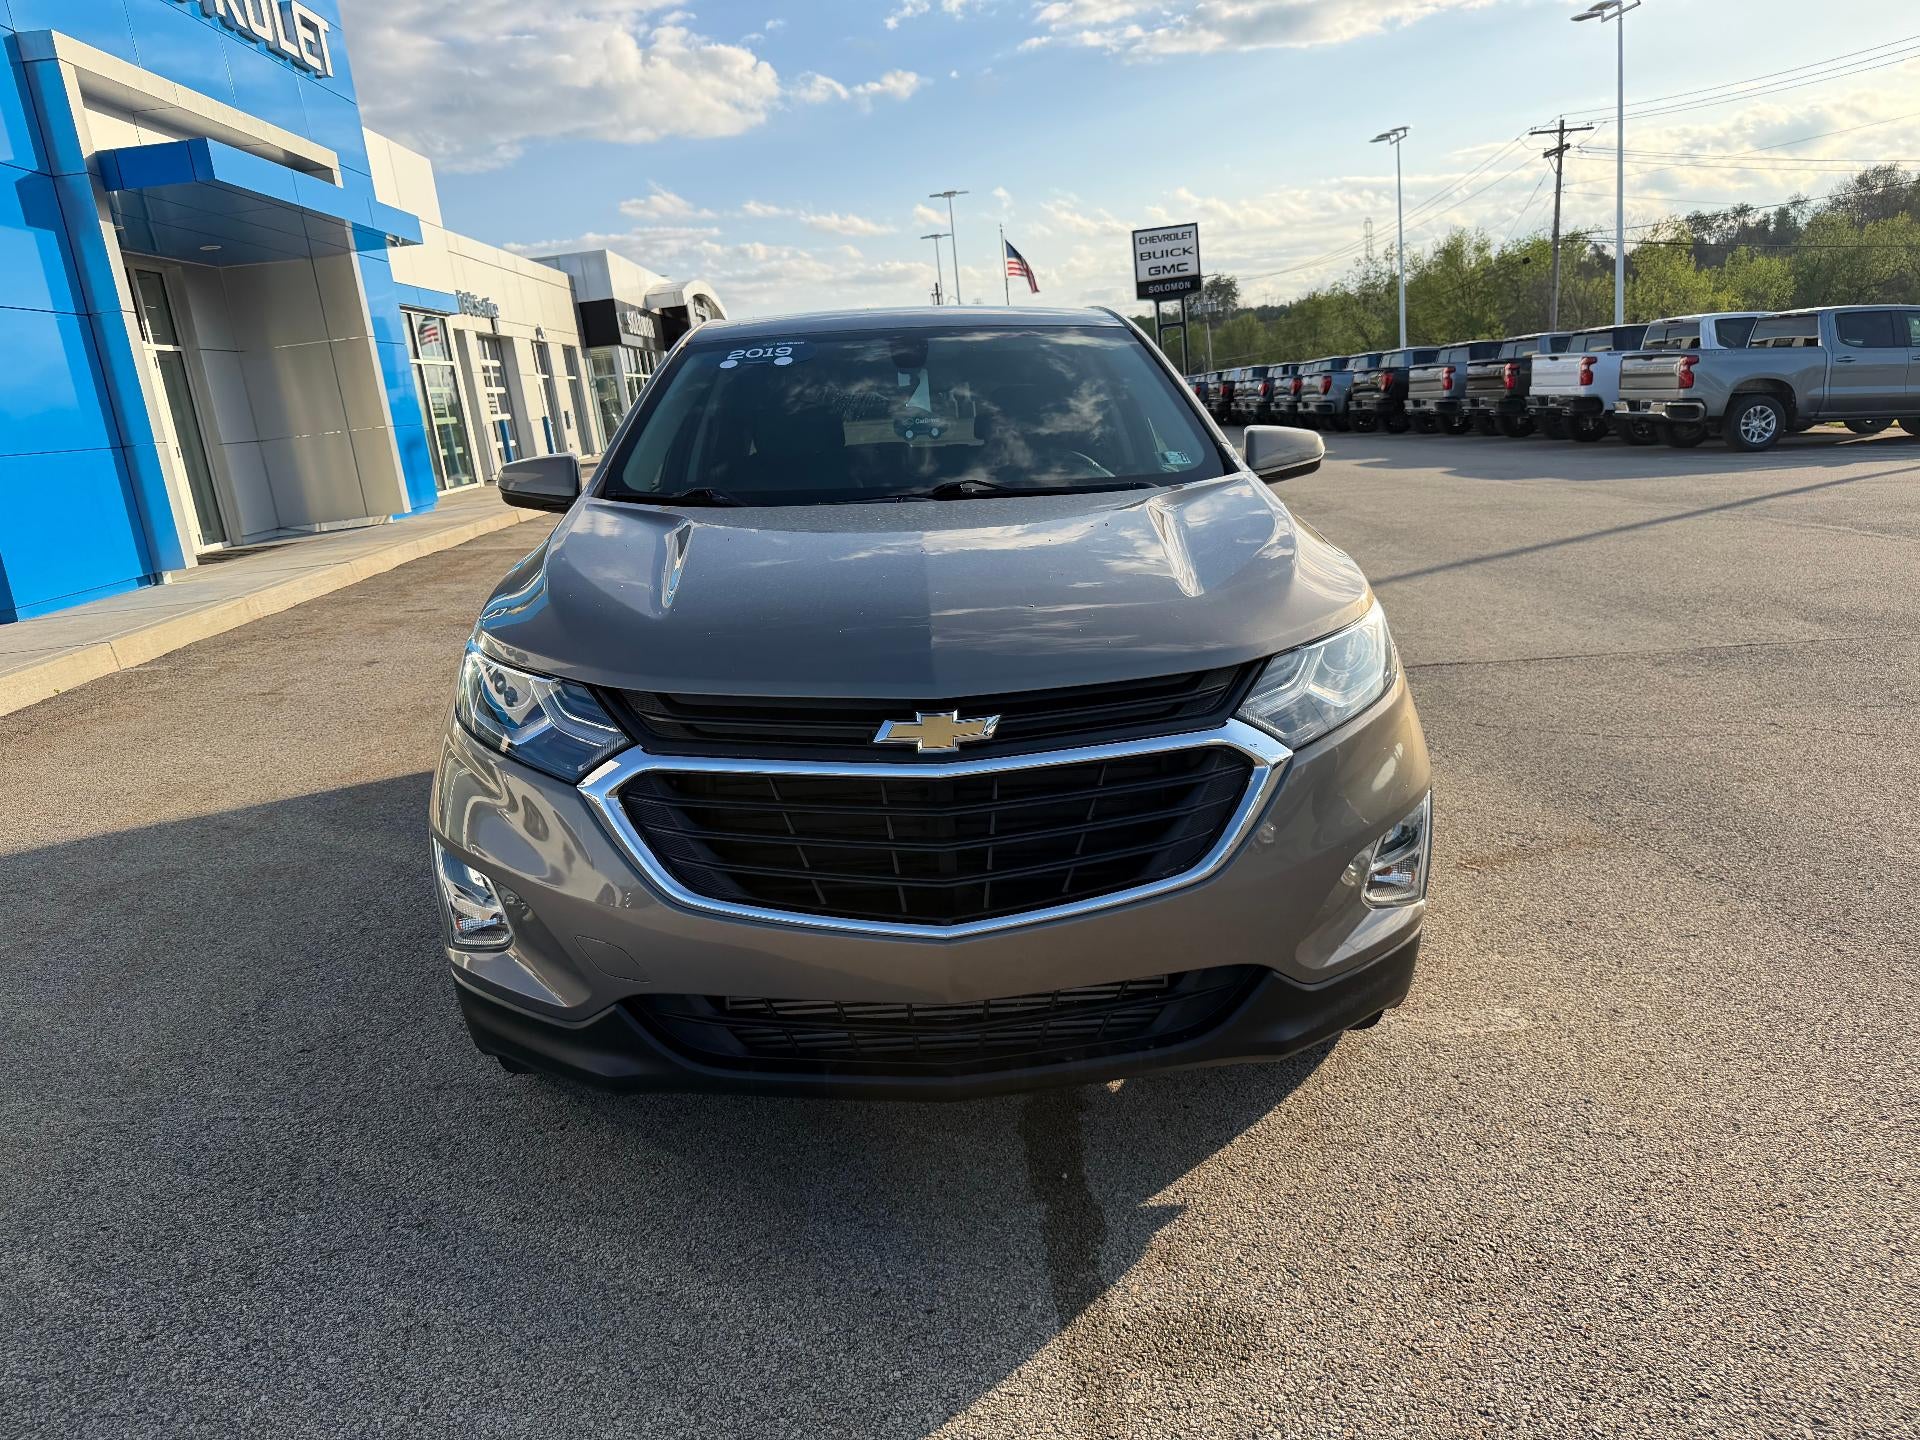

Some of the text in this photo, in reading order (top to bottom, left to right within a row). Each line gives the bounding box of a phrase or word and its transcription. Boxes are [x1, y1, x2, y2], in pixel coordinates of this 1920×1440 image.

[1138, 230, 1192, 245] CHEVROLET
[1139, 246, 1195, 261] BUICK
[1148, 262, 1189, 276] GMC
[1148, 281, 1191, 294] SOLOMON
[726, 346, 793, 360] 2019
